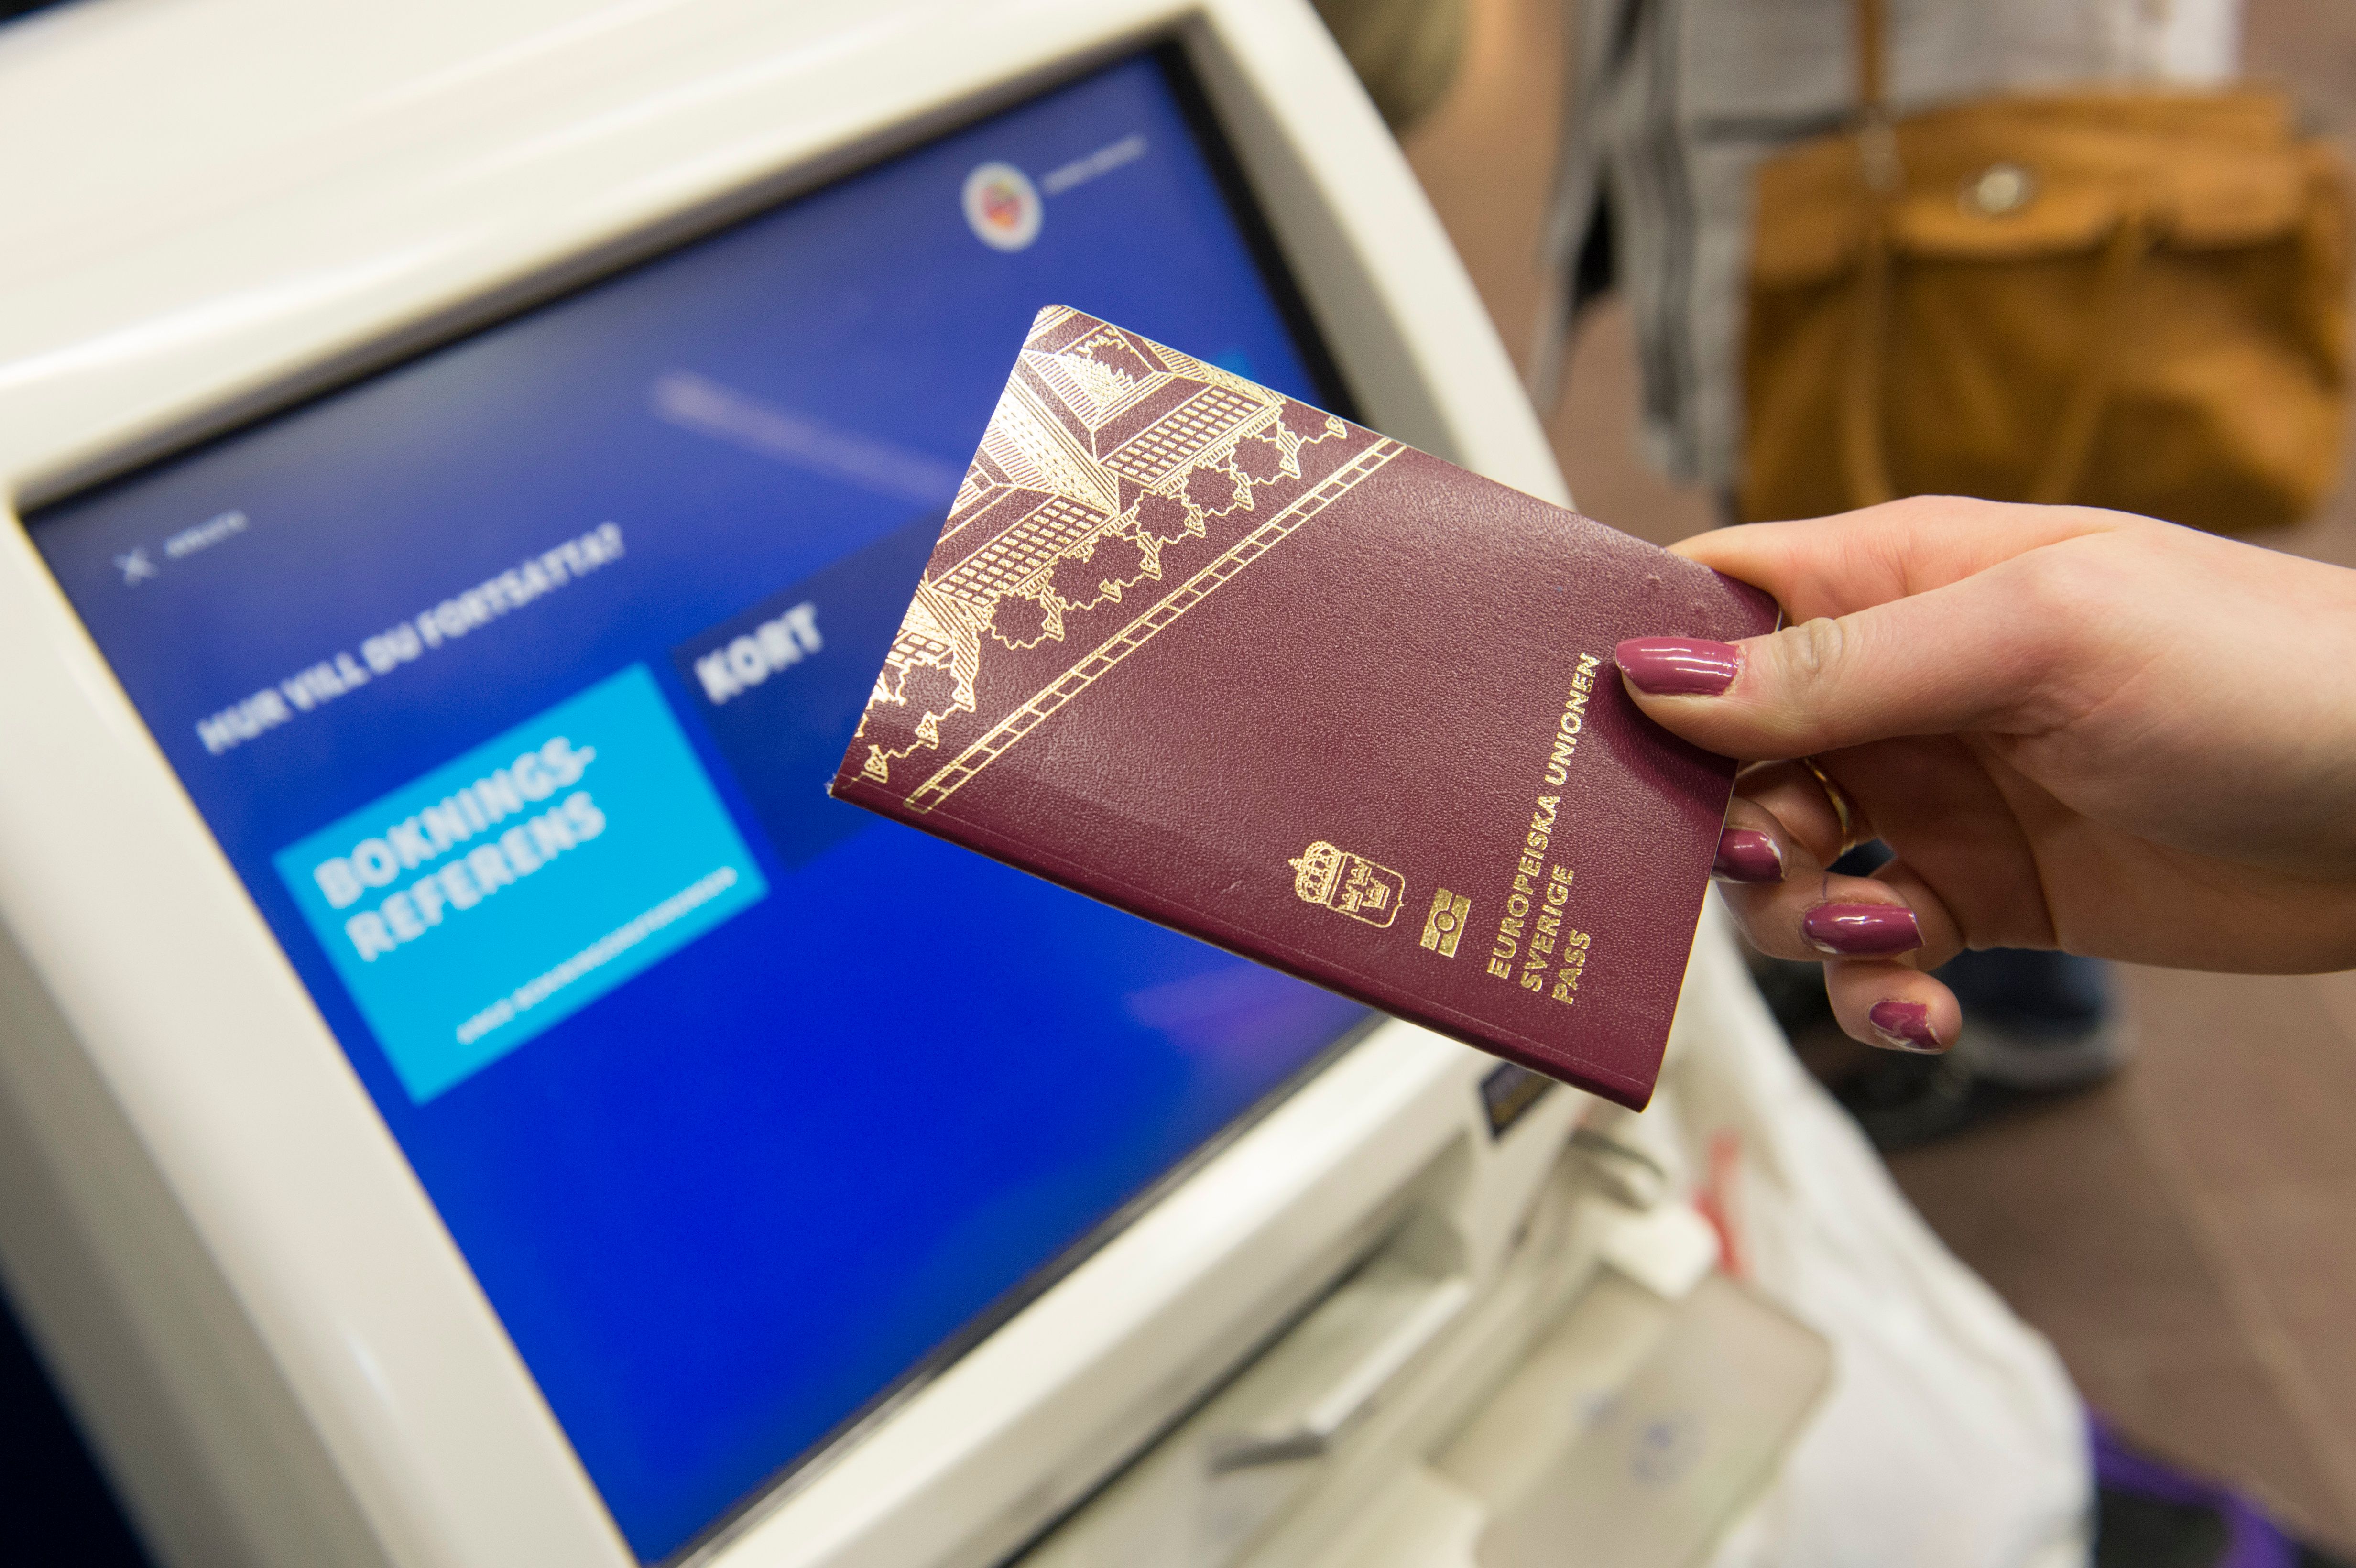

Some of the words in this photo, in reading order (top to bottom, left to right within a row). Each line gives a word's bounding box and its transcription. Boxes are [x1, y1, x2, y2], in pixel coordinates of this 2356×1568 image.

[196, 689, 290, 753] HUR
[282, 653, 370, 711] VILL
[362, 623, 422, 672] DU
[695, 601, 822, 704] KORT
[314, 736, 596, 909] BOKNINGS-
[345, 791, 606, 962] REFERENS
[1487, 795, 1560, 978] EUROPEISKA
[1545, 653, 1599, 785] UNIONEN
[1521, 864, 1574, 992] SVERIGE
[1552, 929, 1591, 1004] PASS
